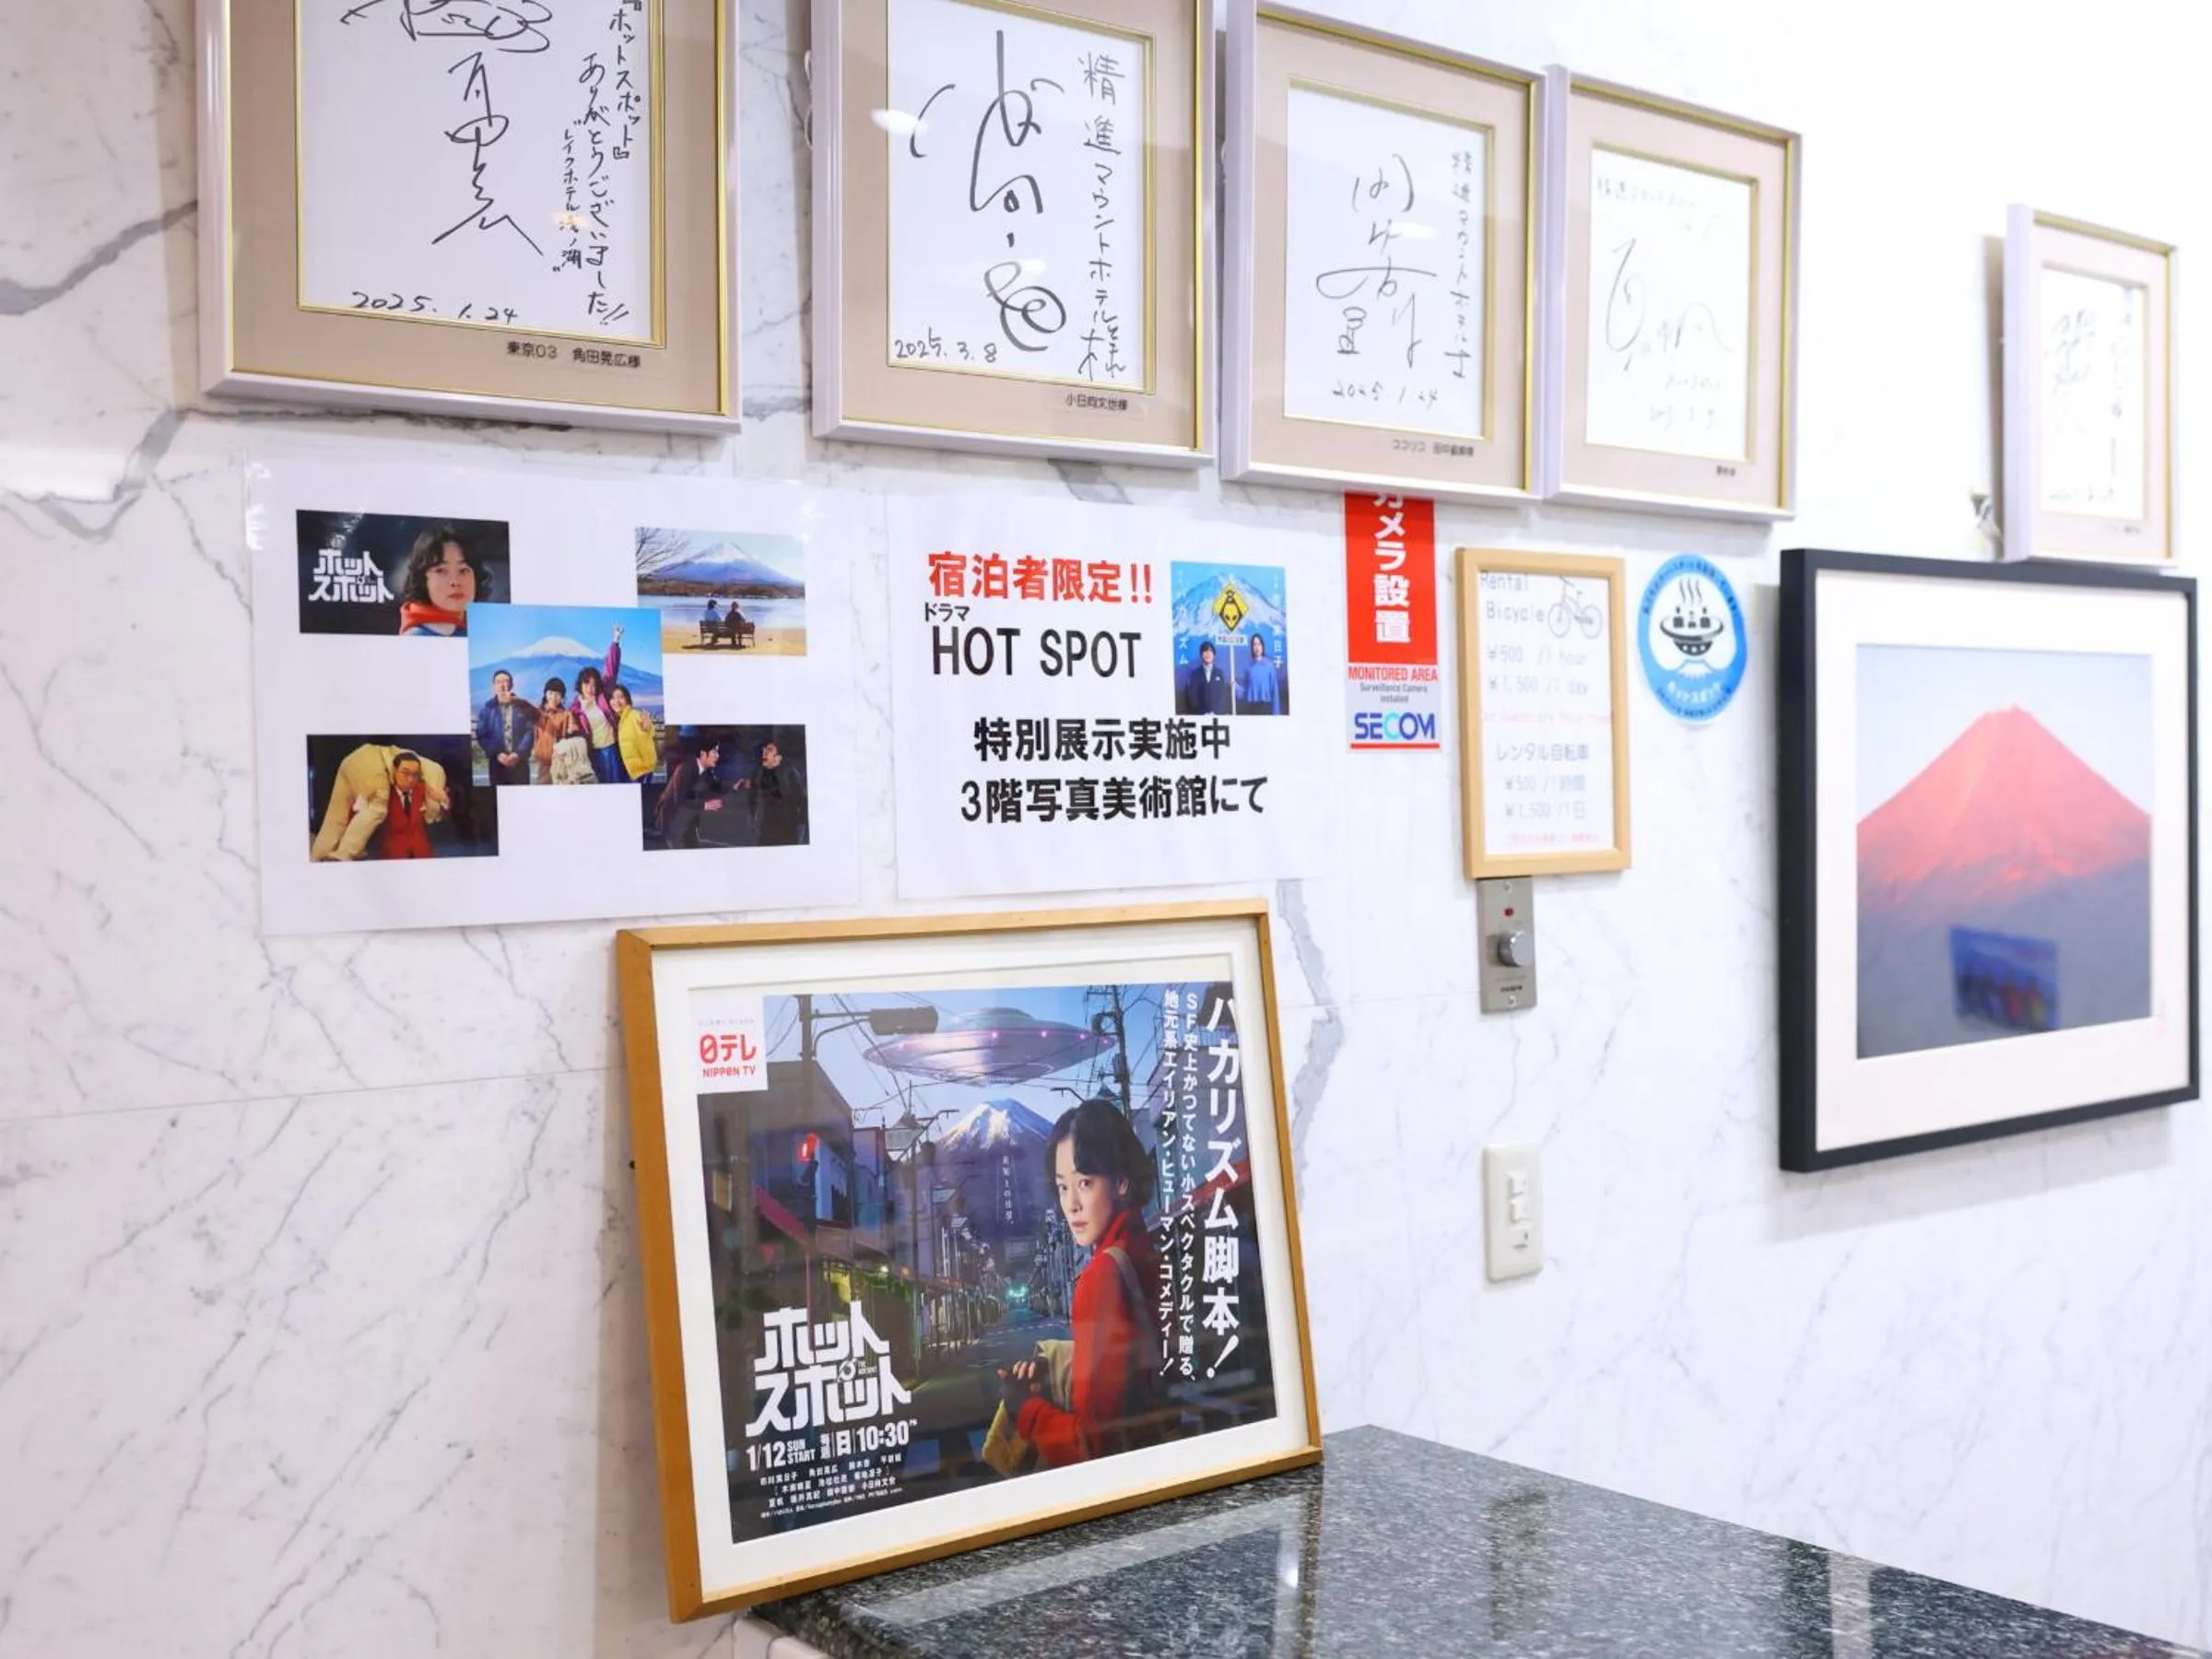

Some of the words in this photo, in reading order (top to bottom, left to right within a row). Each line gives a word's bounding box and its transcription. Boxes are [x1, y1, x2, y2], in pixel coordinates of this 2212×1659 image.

[507, 340, 558, 359] 東京03
[572, 347, 641, 369] 角田晃広様
[927, 551, 1153, 604] 宿泊者限定!!
[1480, 571, 1529, 592] Rental
[924, 603, 971, 622] ドラマ
[1486, 600, 1546, 625] Bicycle
[932, 625, 1021, 677] HOT
[1039, 629, 1143, 678] SPOT
[1347, 665, 1407, 682] MONITORED
[1410, 666, 1439, 682] AREA
[972, 716, 1231, 762] 特別展示実施中
[1354, 712, 1436, 741] SECOM
[1496, 742, 1590, 761] レンタル自転車
[960, 774, 1269, 825] 3階写真美術館にて
[700, 1032, 757, 1064] 日テレ
[702, 1066, 740, 1078] NIPPON
[742, 1065, 756, 1077] TV
[754, 1300, 890, 1372] ホット
[745, 1355, 912, 1439] スポット
[786, 1438, 806, 1453] SUN
[856, 1419, 910, 1453] 10:30
[745, 1440, 786, 1472] 1/12
[786, 1448, 817, 1465] START
